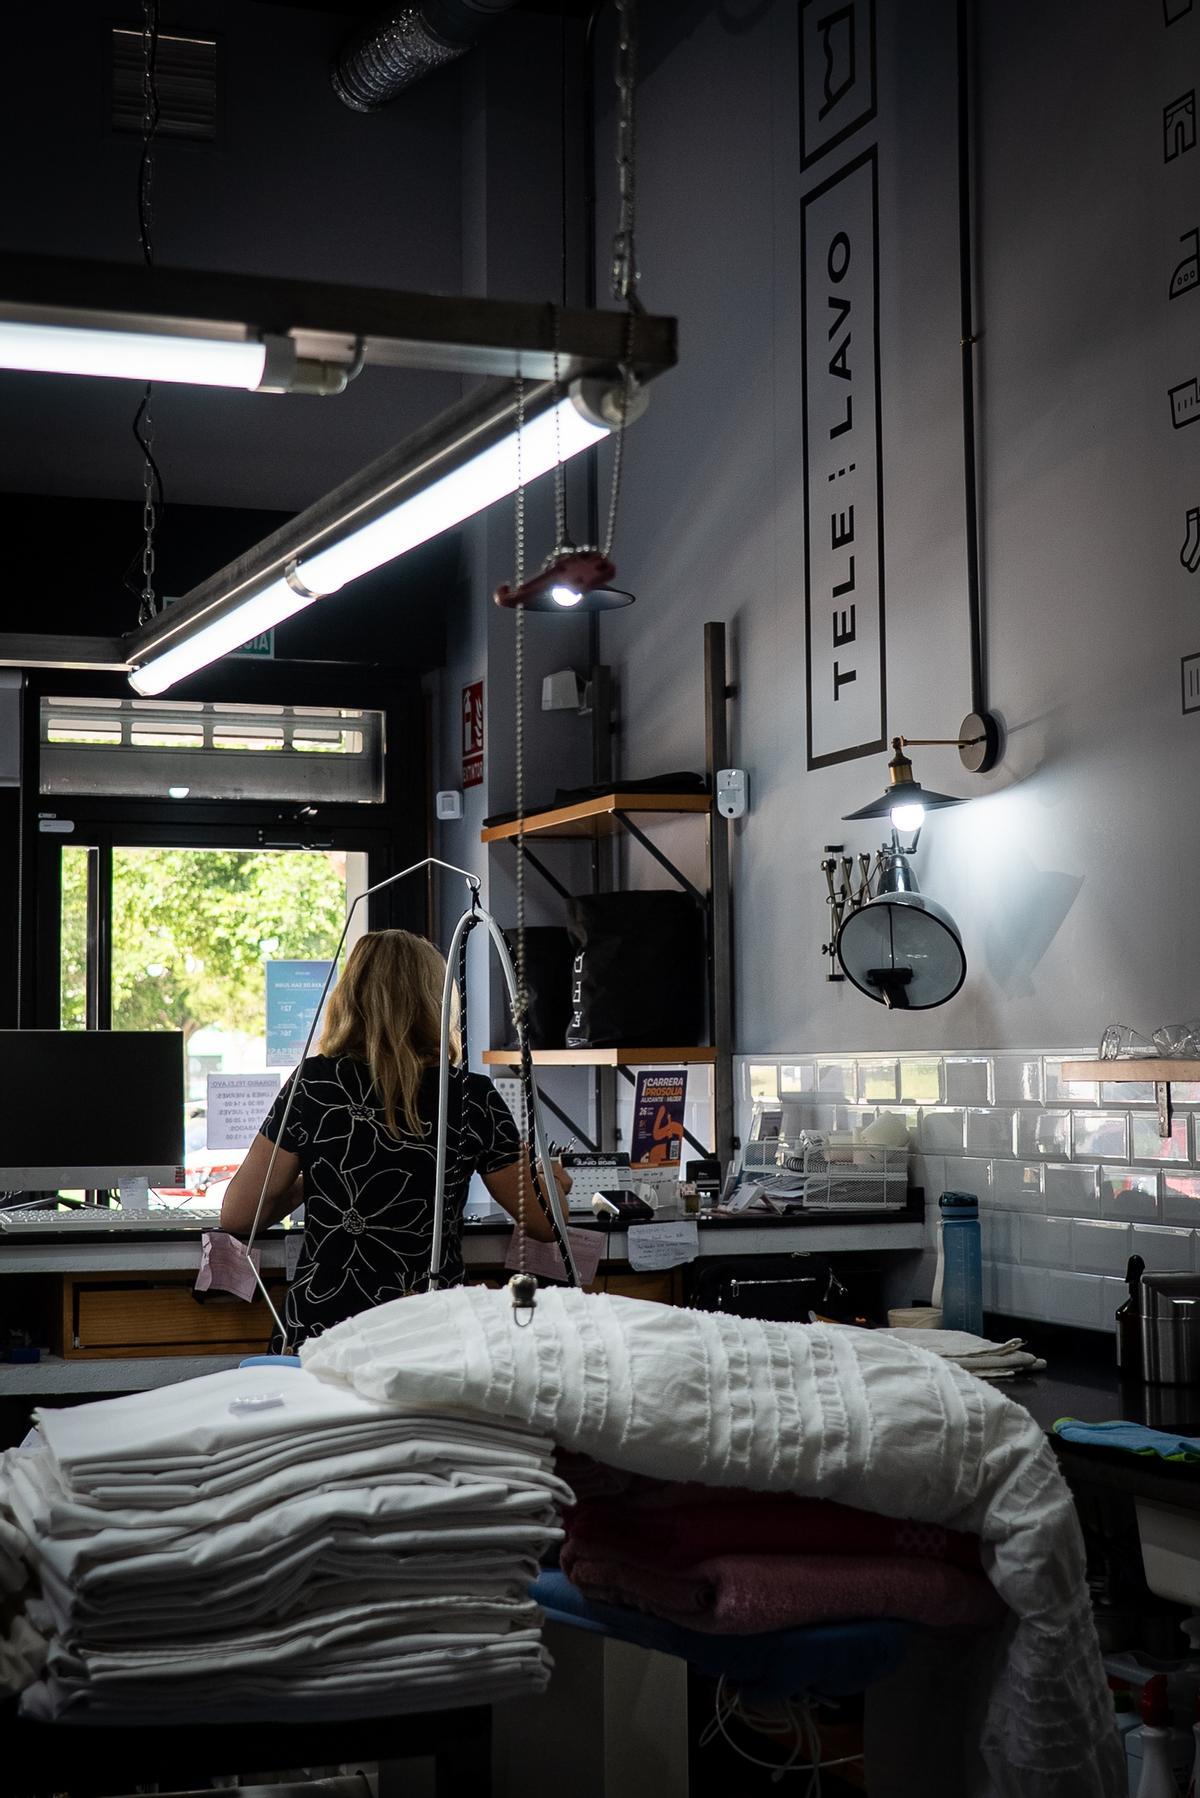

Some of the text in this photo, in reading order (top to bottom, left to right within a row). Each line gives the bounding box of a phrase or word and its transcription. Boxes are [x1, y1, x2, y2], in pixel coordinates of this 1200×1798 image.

[828, 231, 857, 702] TELE LAVO
[647, 1077, 684, 1087] CARRERA
